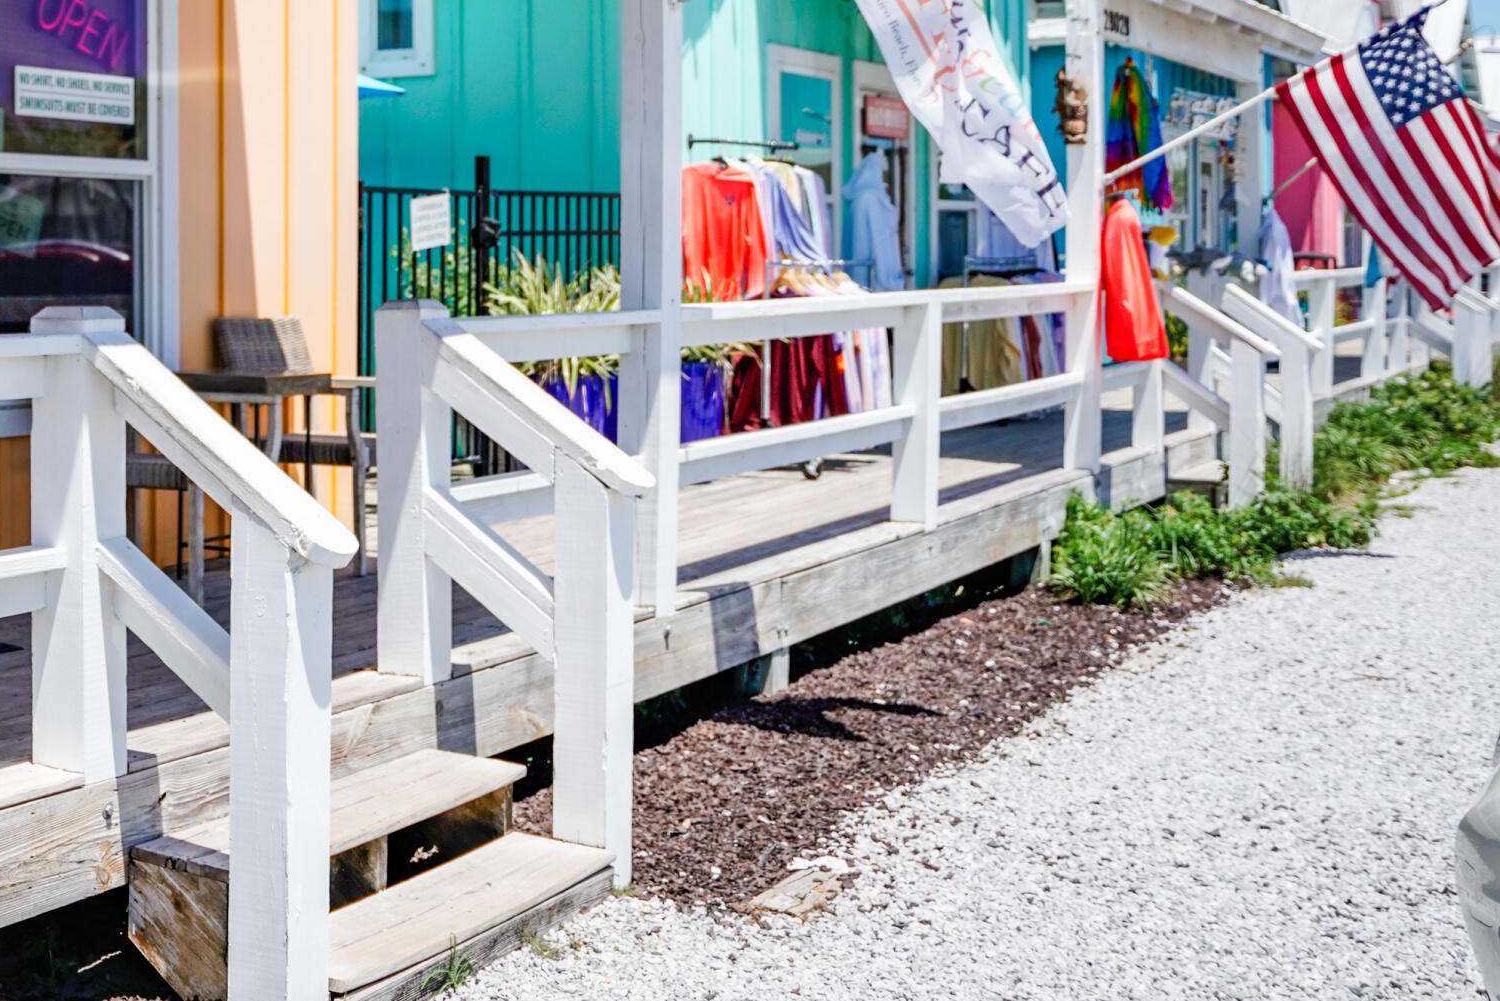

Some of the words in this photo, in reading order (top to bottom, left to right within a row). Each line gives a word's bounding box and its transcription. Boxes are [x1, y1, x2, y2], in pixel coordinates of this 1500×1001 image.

[20, 72, 29, 84] NO
[56, 77, 65, 88] NO
[92, 81, 102, 92] NO
[20, 96, 63, 112] SWIMSUITS
[65, 101, 85, 113] MUST
[88, 102, 97, 115] BE
[99, 104, 130, 118] COVERED
